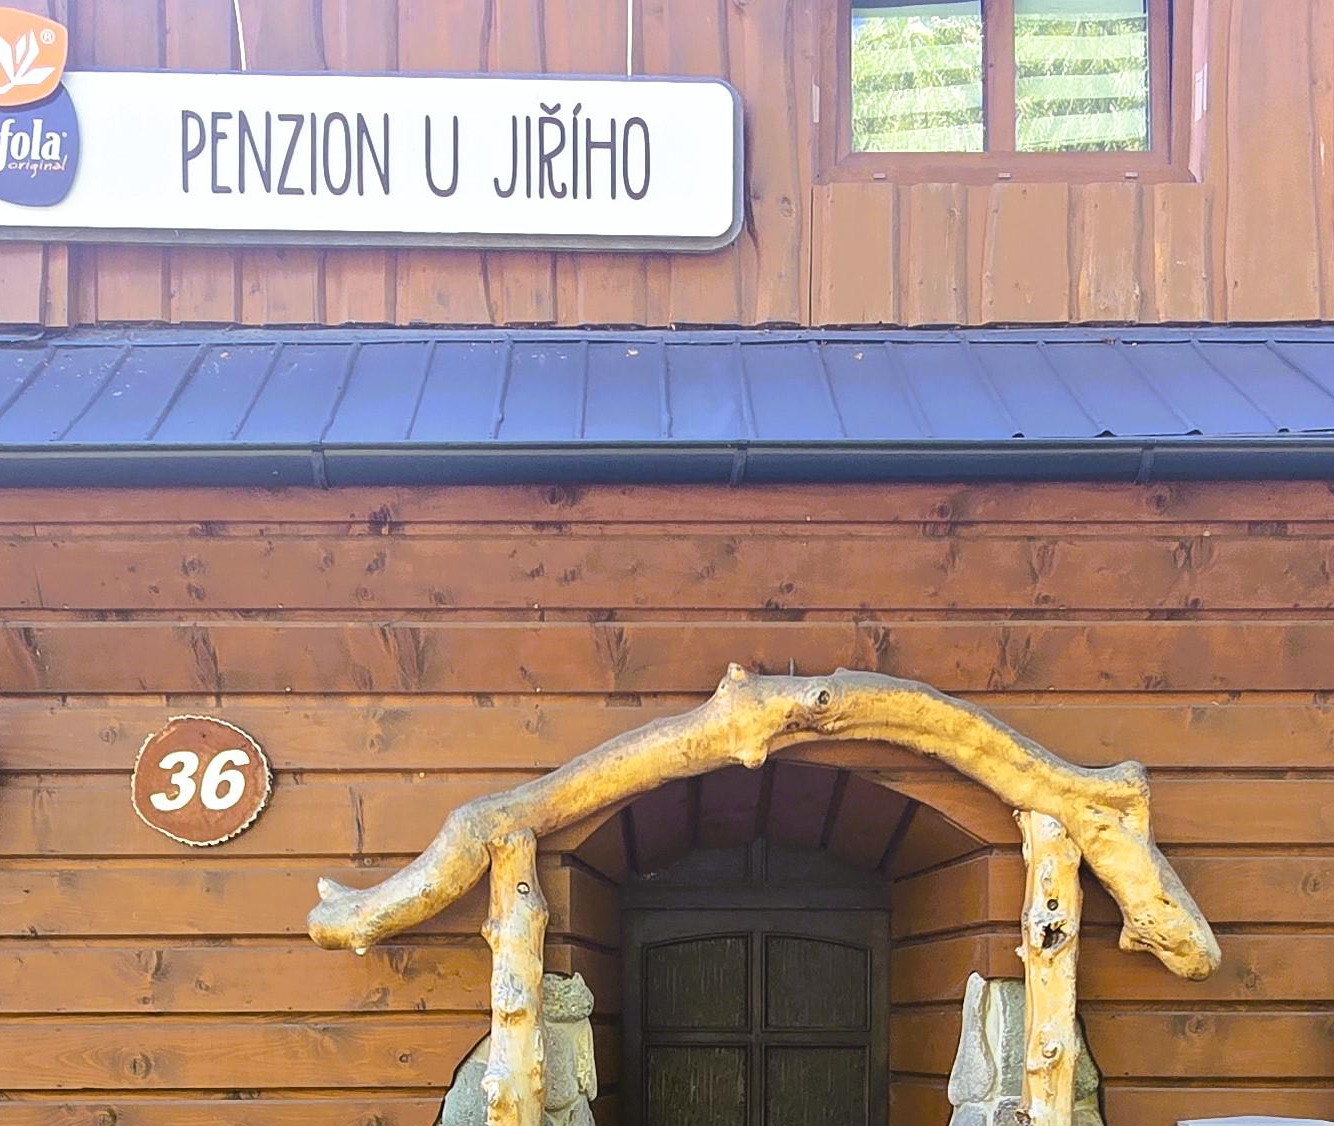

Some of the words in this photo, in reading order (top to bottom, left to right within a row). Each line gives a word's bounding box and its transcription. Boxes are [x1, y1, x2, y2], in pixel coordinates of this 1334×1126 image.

[7, 155, 68, 178] original
[181, 110, 390, 196] PENZION
[424, 115, 459, 198] U
[494, 102, 650, 200] JIŘÍHO
[150, 749, 250, 811] 36
